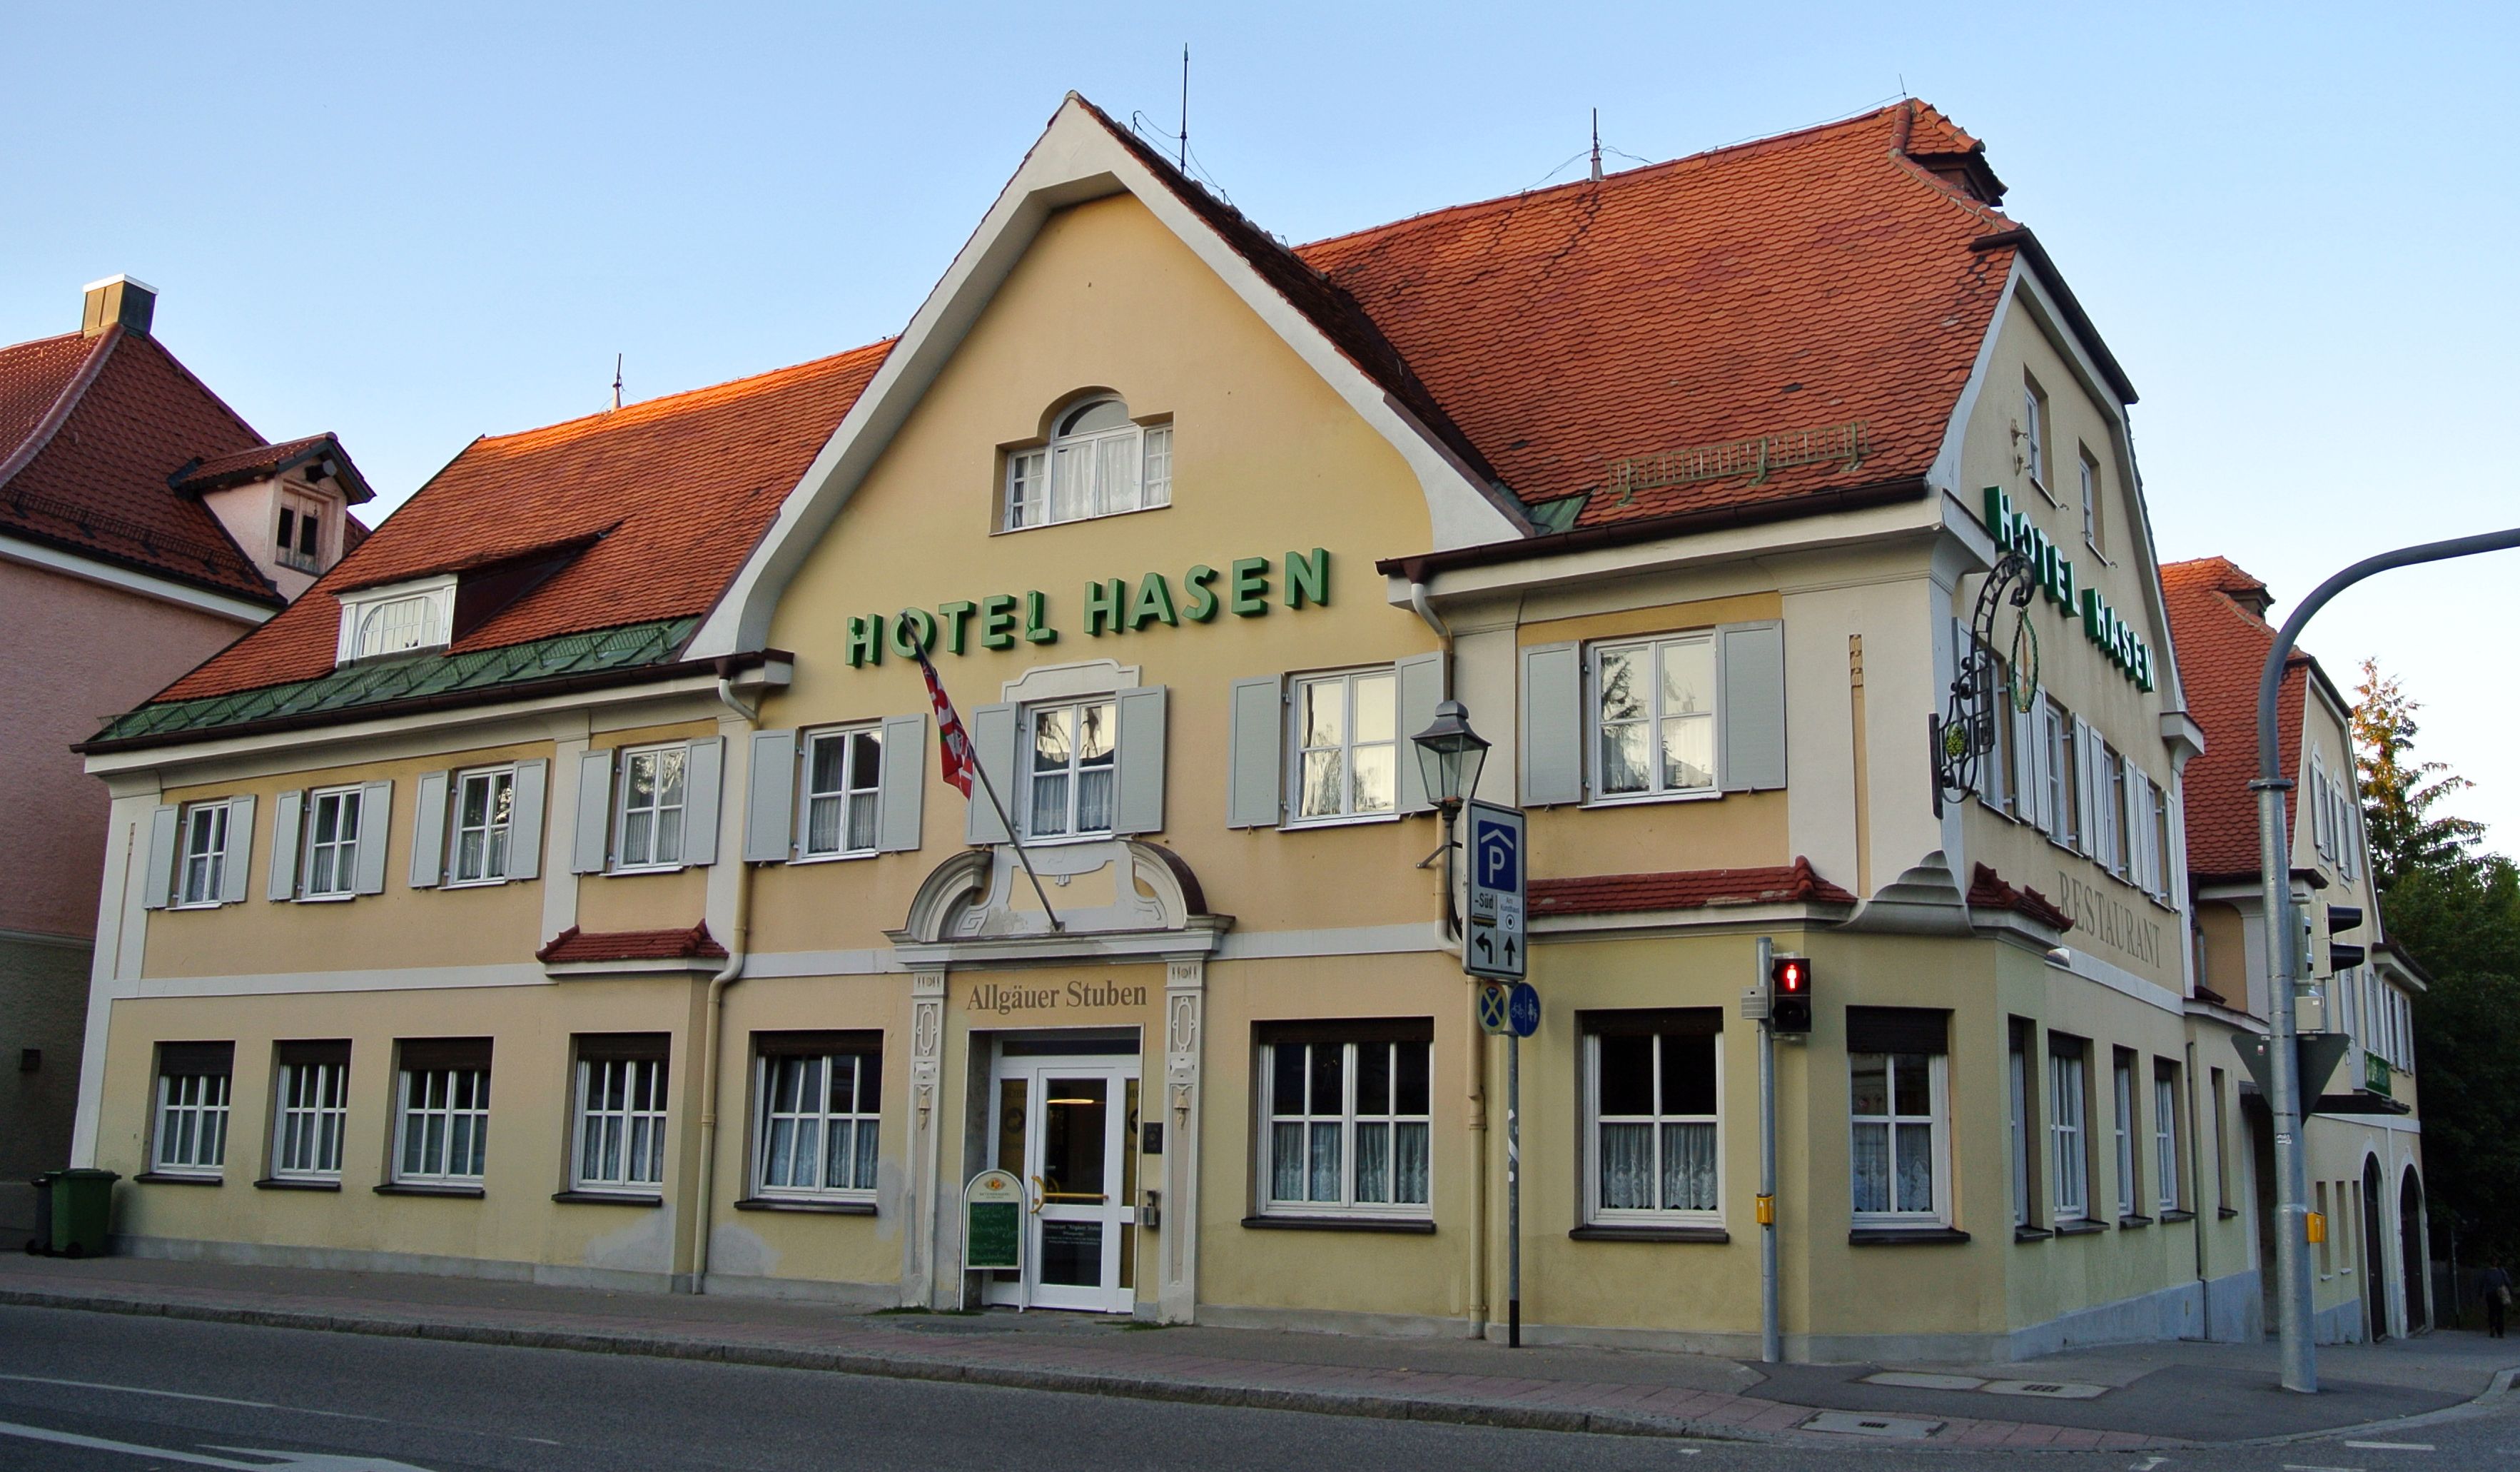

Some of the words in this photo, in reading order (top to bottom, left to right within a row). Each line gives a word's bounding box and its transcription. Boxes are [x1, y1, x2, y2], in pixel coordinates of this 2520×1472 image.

[845, 590, 1058, 668] HOTEL
[1083, 547, 1330, 637] HASEN
[1984, 485, 2080, 618] HOTEL
[2082, 588, 2155, 693] HASEN
[1489, 845, 1506, 884] P
[2058, 870, 2161, 969] RESTAURANT
[966, 984, 1061, 1015] Allgäuer
[1066, 979, 1148, 1009] Stuben
